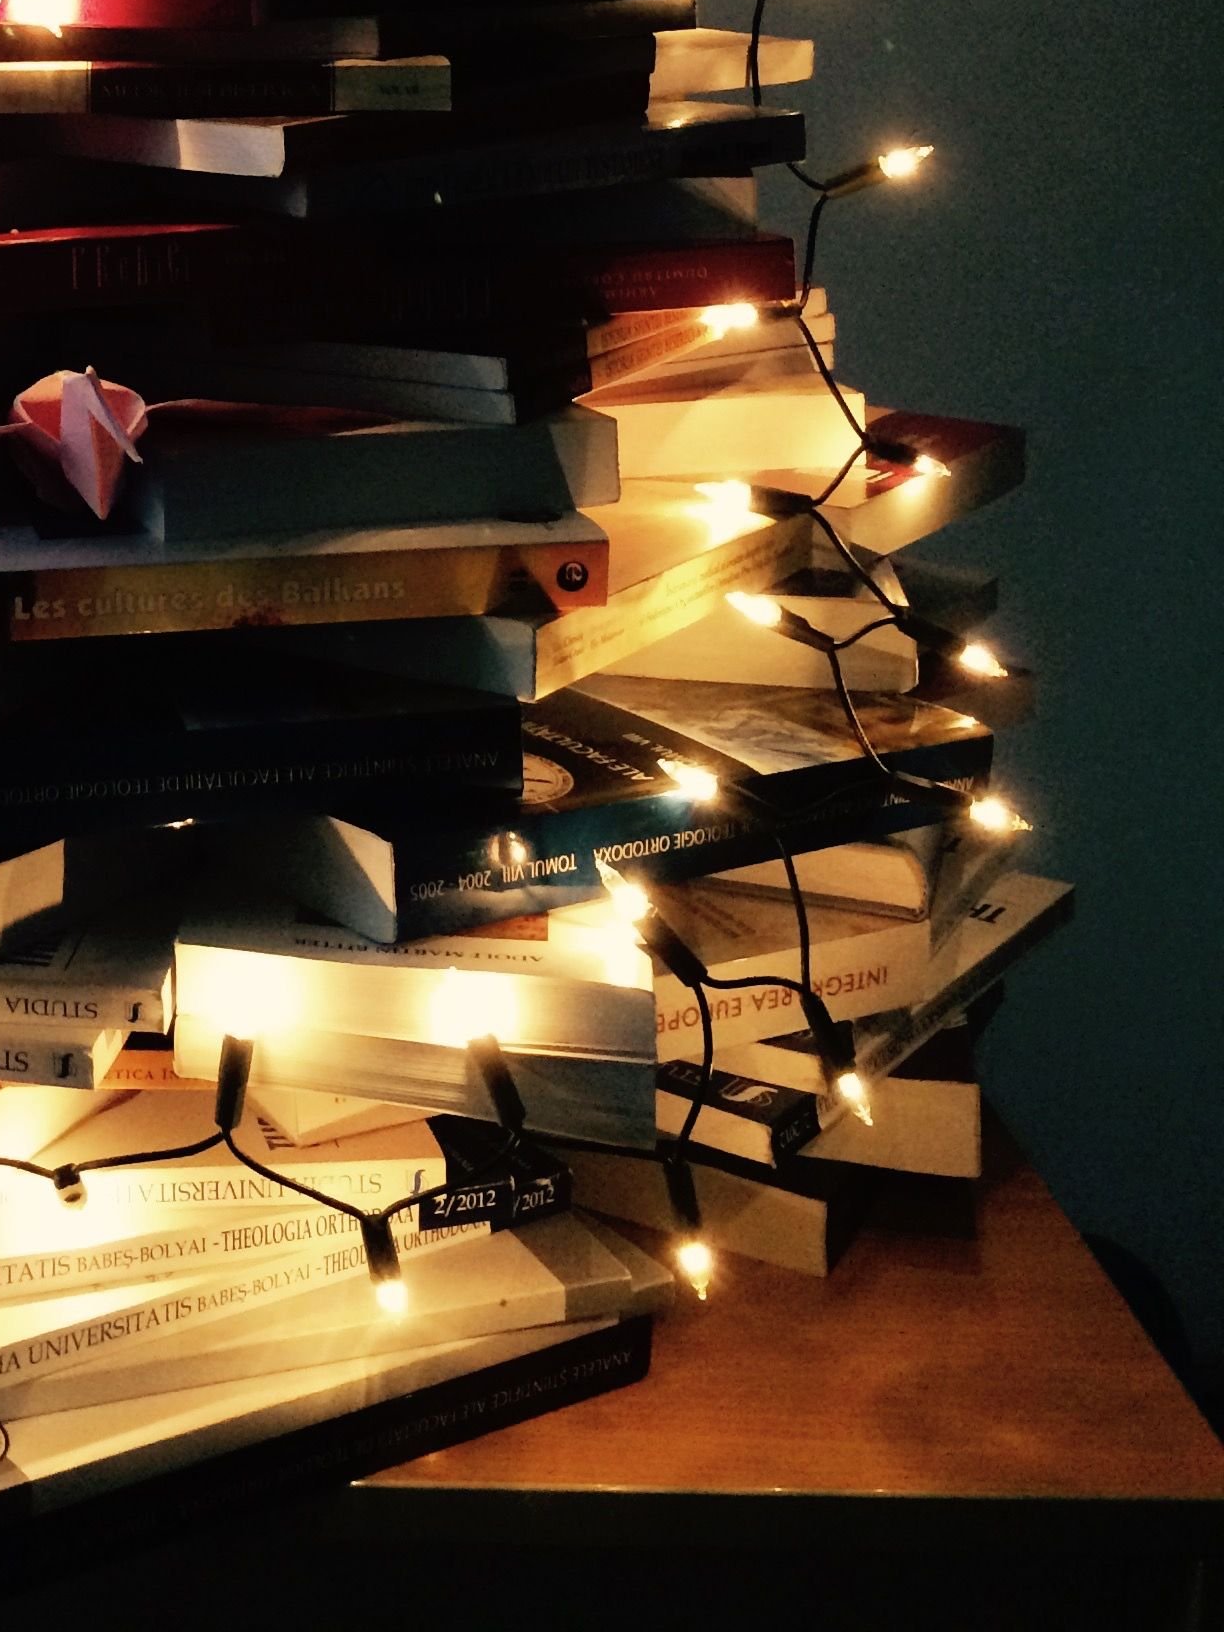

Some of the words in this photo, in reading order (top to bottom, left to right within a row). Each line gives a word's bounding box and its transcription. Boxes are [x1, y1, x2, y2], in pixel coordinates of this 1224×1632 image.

[13, 595, 67, 621] Les
[77, 586, 205, 618] cultures
[214, 582, 268, 608] des
[280, 577, 405, 608] Balkans
[501, 864, 525, 884] VIII
[526, 852, 578, 879] TOMUL
[409, 879, 446, 902] 2005
[457, 869, 493, 893] 2004
[751, 965, 890, 1012] INTEGRREA
[4, 996, 99, 1020] STUDIA
[432, 1189, 497, 1218] 2/2012
[76, 1237, 208, 1274] BABEȘ-BOLYAI
[28, 1295, 192, 1365] UNIVERSITATIS
[196, 1263, 311, 1314] BABEȘ-BOLYAI
